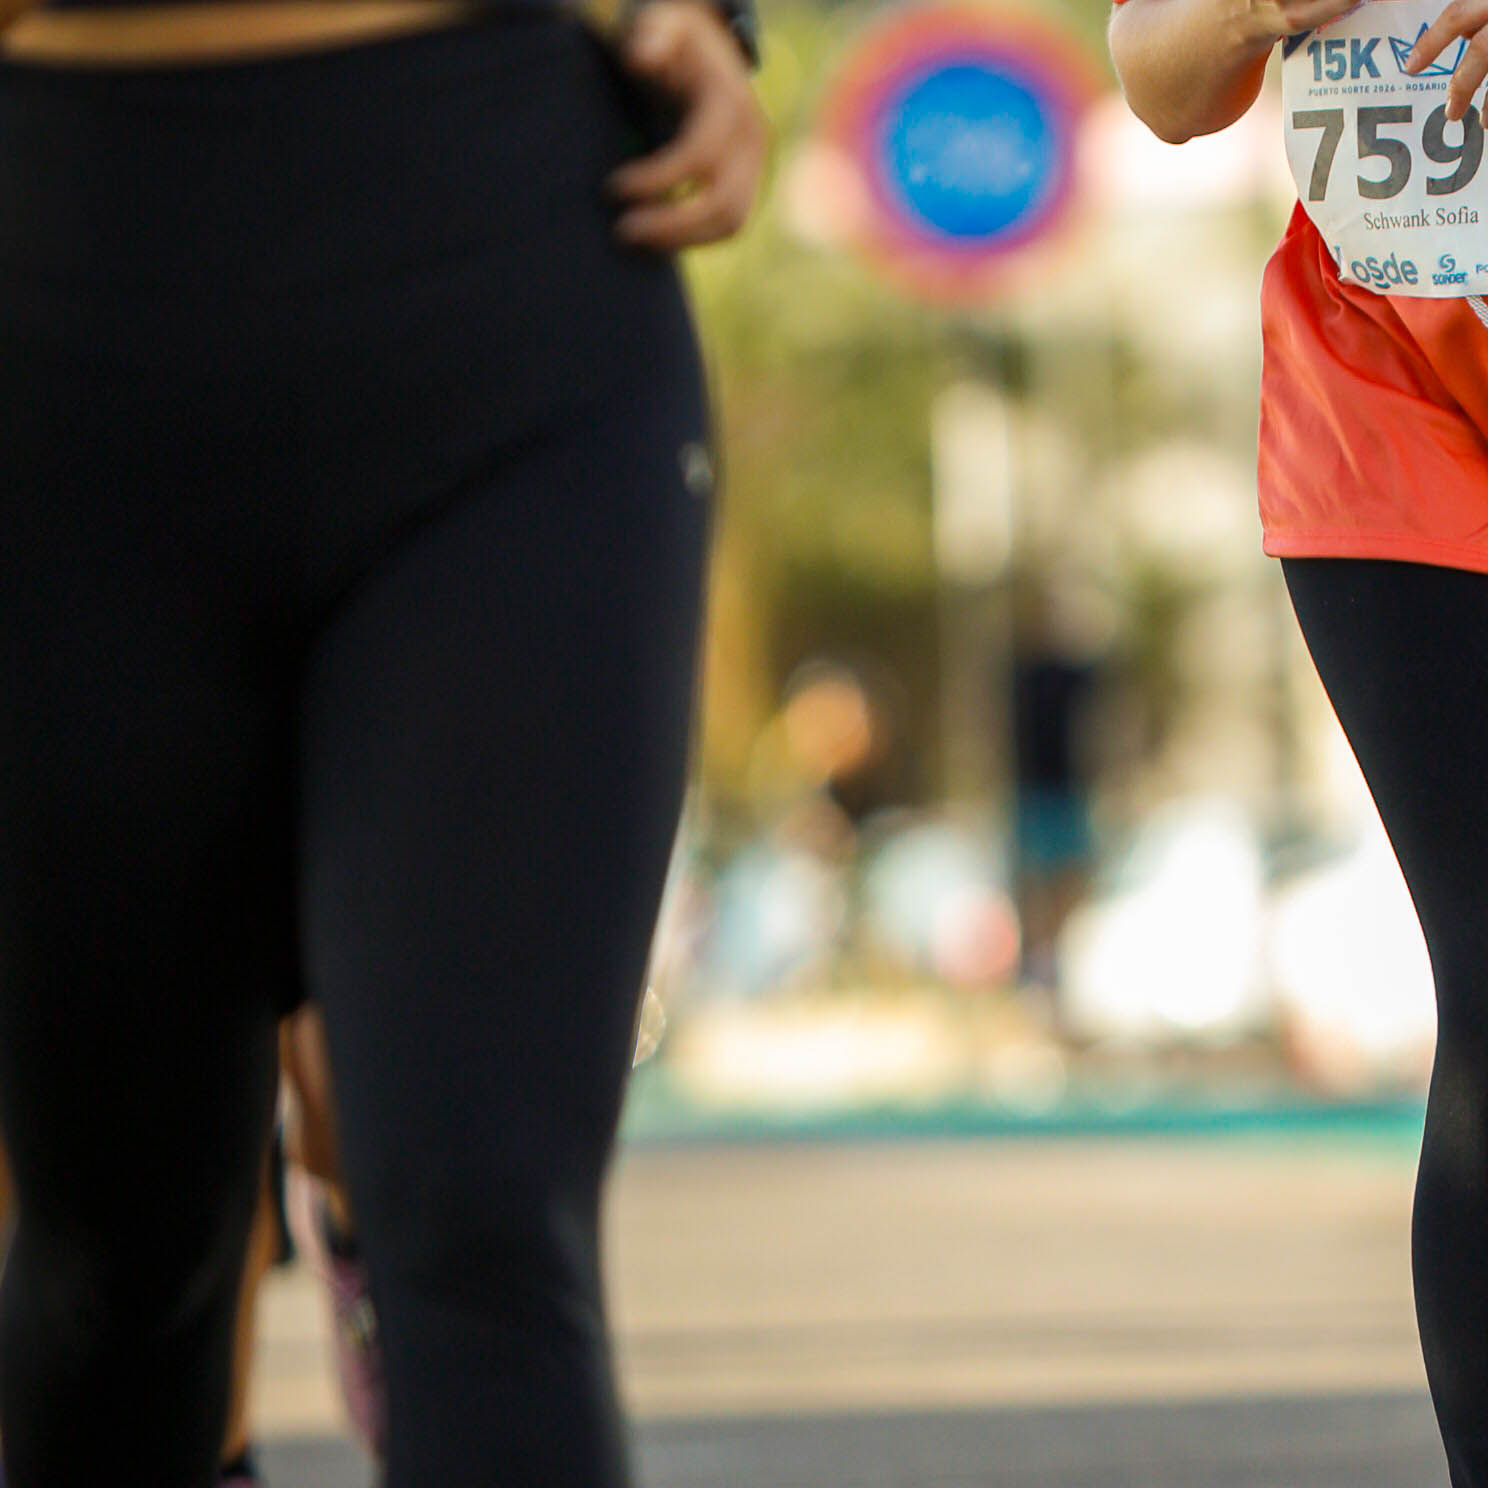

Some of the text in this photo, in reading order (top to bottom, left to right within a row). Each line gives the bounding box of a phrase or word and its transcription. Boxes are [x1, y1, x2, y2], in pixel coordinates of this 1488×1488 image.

[1306, 37, 1381, 82] 15K
[1308, 87, 1339, 96] PUERTO
[1341, 85, 1370, 94] NORTE
[1373, 84, 1396, 92] 2026
[1405, 81, 1447, 91] ROSARIO
[1363, 206, 1480, 230] Schwank Sofia
[1351, 252, 1418, 287] osde
